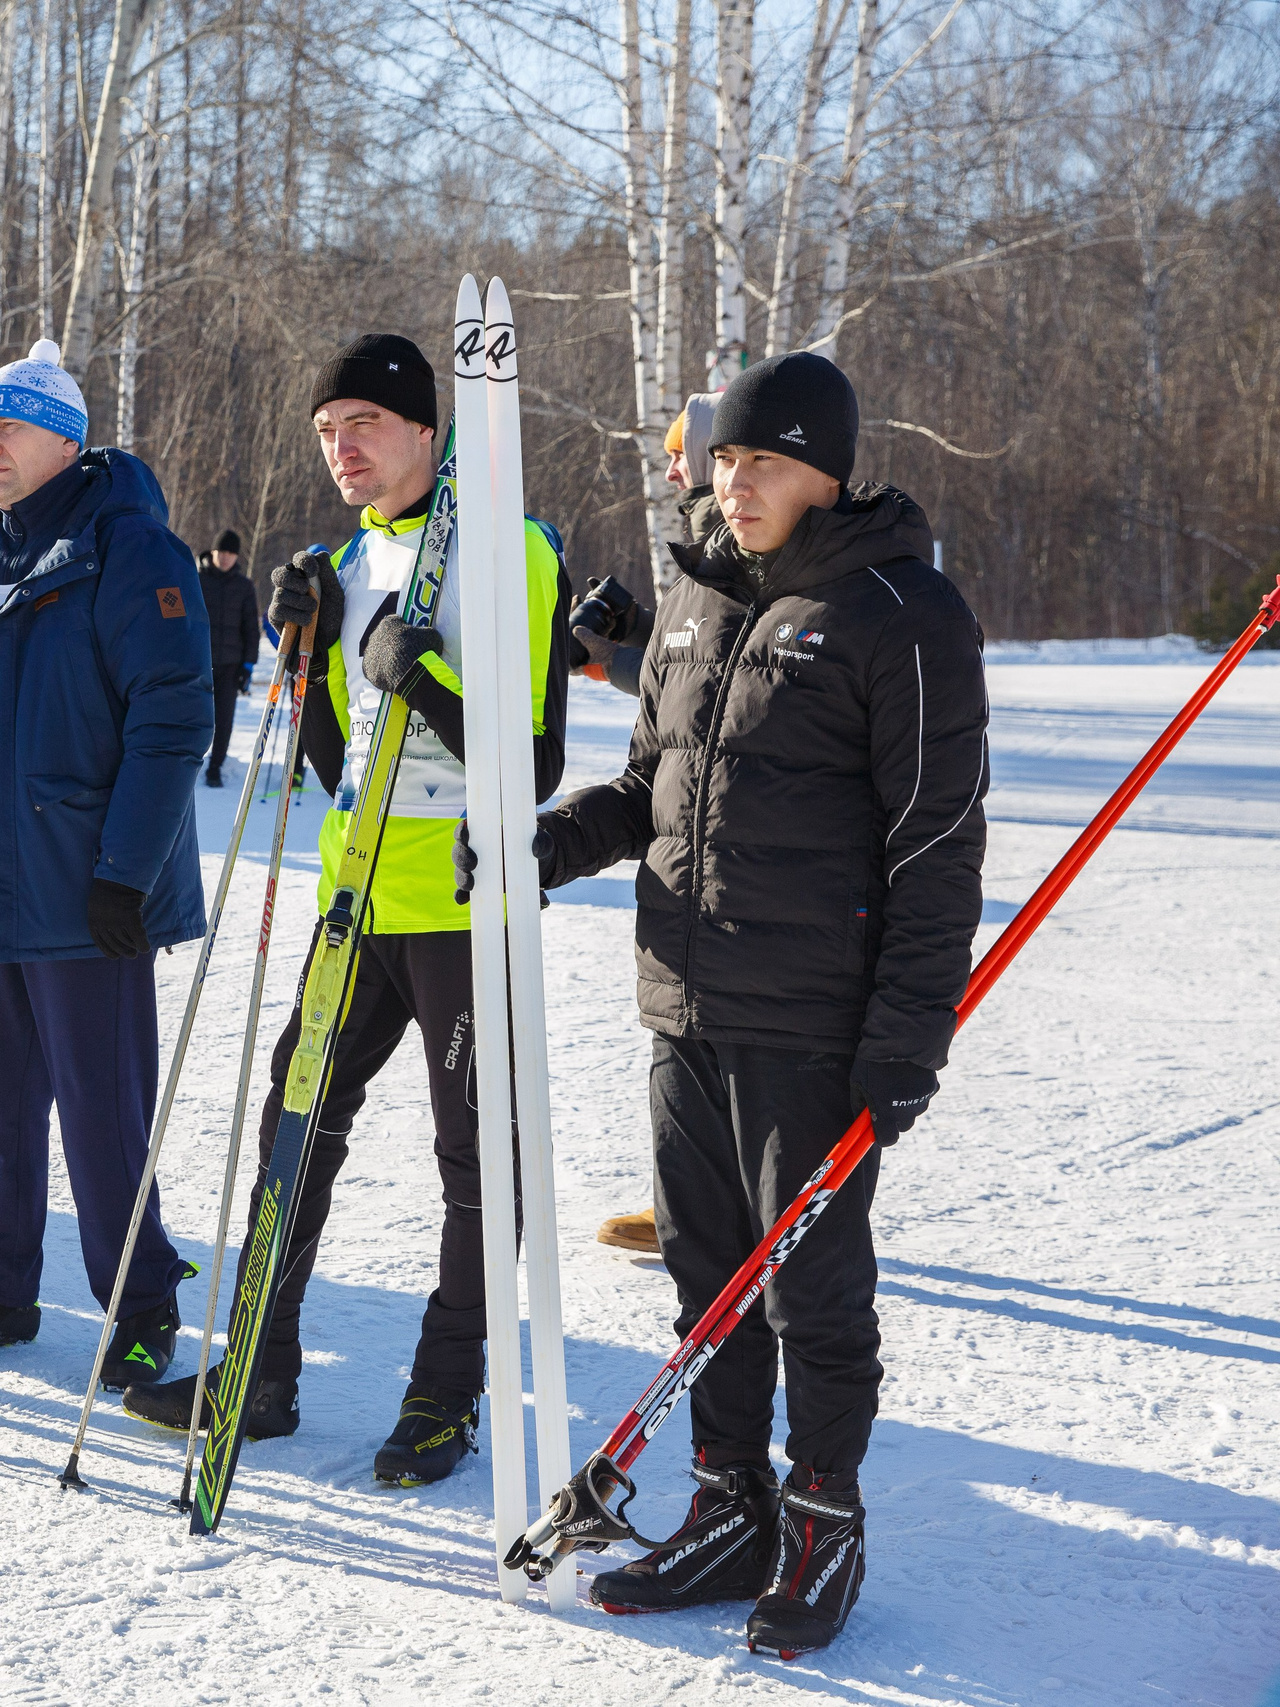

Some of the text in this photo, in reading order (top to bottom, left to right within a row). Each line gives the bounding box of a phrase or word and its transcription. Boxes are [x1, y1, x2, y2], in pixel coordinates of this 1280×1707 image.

[779, 433, 807, 445] DEMIX
[663, 631, 693, 649] PUMA
[773, 647, 815, 661] Motorsport
[445, 1022, 466, 1070] CRAFT
[274, 1178, 282, 1199] PLUS
[735, 1266, 773, 1316] WORLD CUP
[671, 1339, 694, 1366] exel
[644, 1337, 725, 1440] exel
[787, 1494, 854, 1518] MADSHUS
